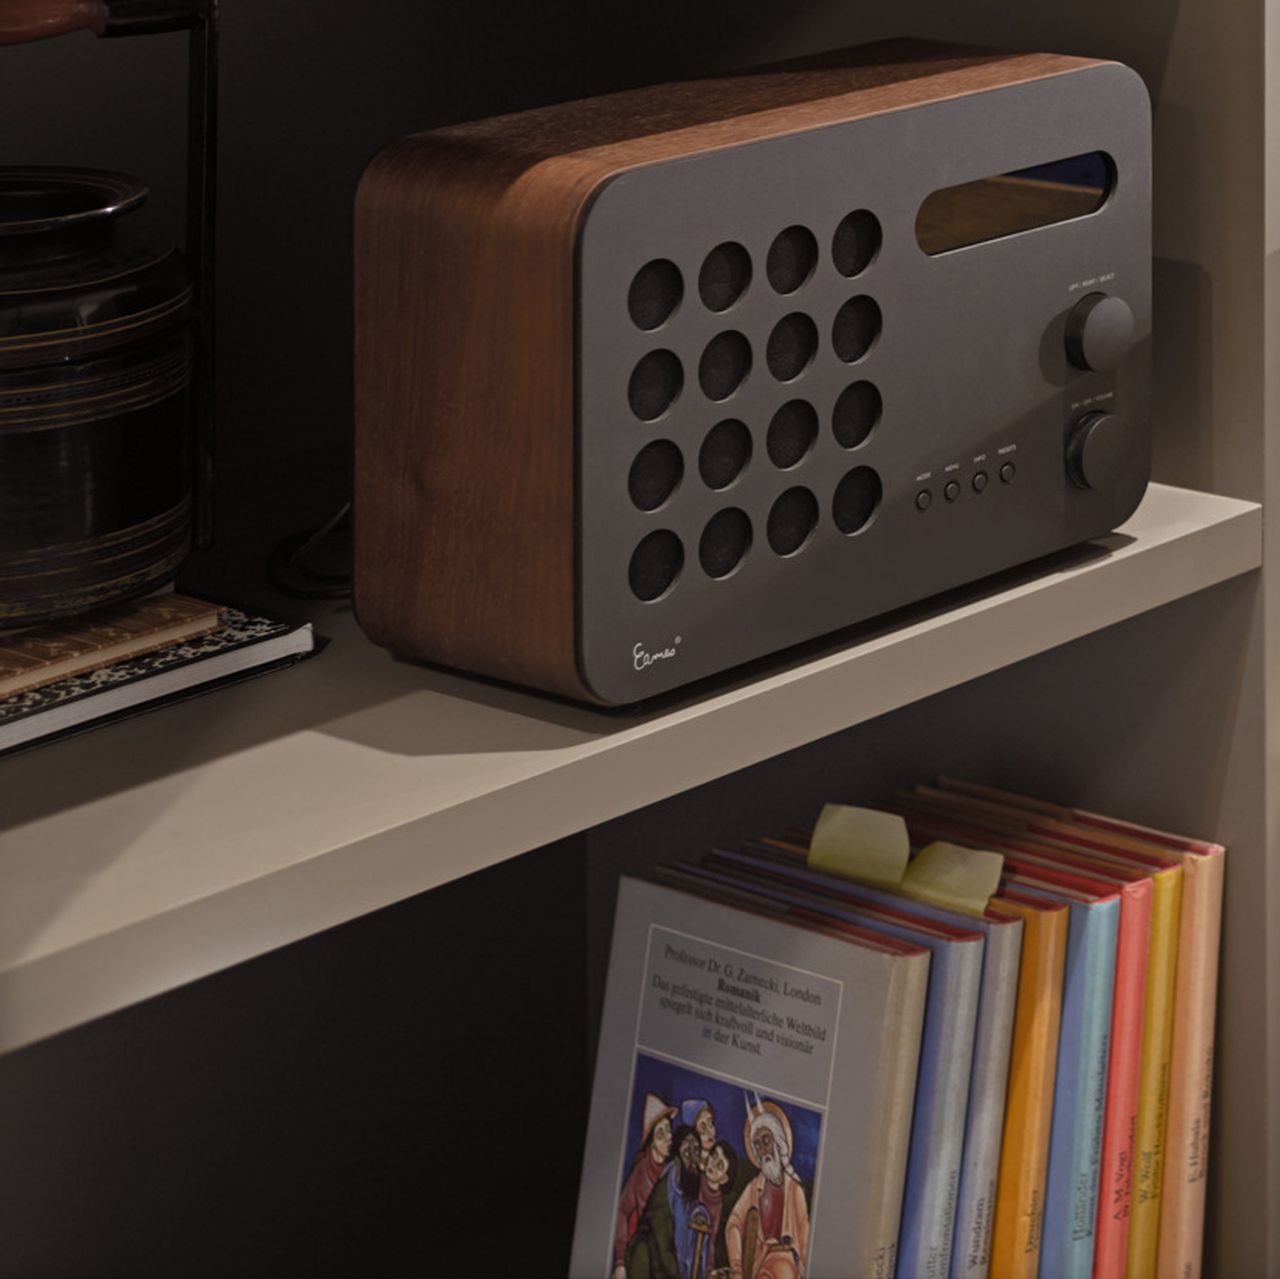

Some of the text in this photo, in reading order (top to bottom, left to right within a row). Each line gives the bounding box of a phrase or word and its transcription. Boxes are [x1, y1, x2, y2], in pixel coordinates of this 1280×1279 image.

[633, 641, 677, 671] Eames
[665, 943, 706, 969] Professor
[723, 963, 735, 978] G.
[783, 981, 822, 1007] London
[718, 977, 761, 1004] Romanik
[652, 973, 669, 992] Das
[715, 998, 784, 1028] mittelalterliche
[786, 1016, 827, 1042] Weltbild
[660, 996, 815, 1055] spiegelt sich kraftvoll und visionär
[702, 1022, 762, 1056] in der Kunst.
[1140, 1151, 1153, 1183] Wolf
[967, 1197, 985, 1270] Wundram
